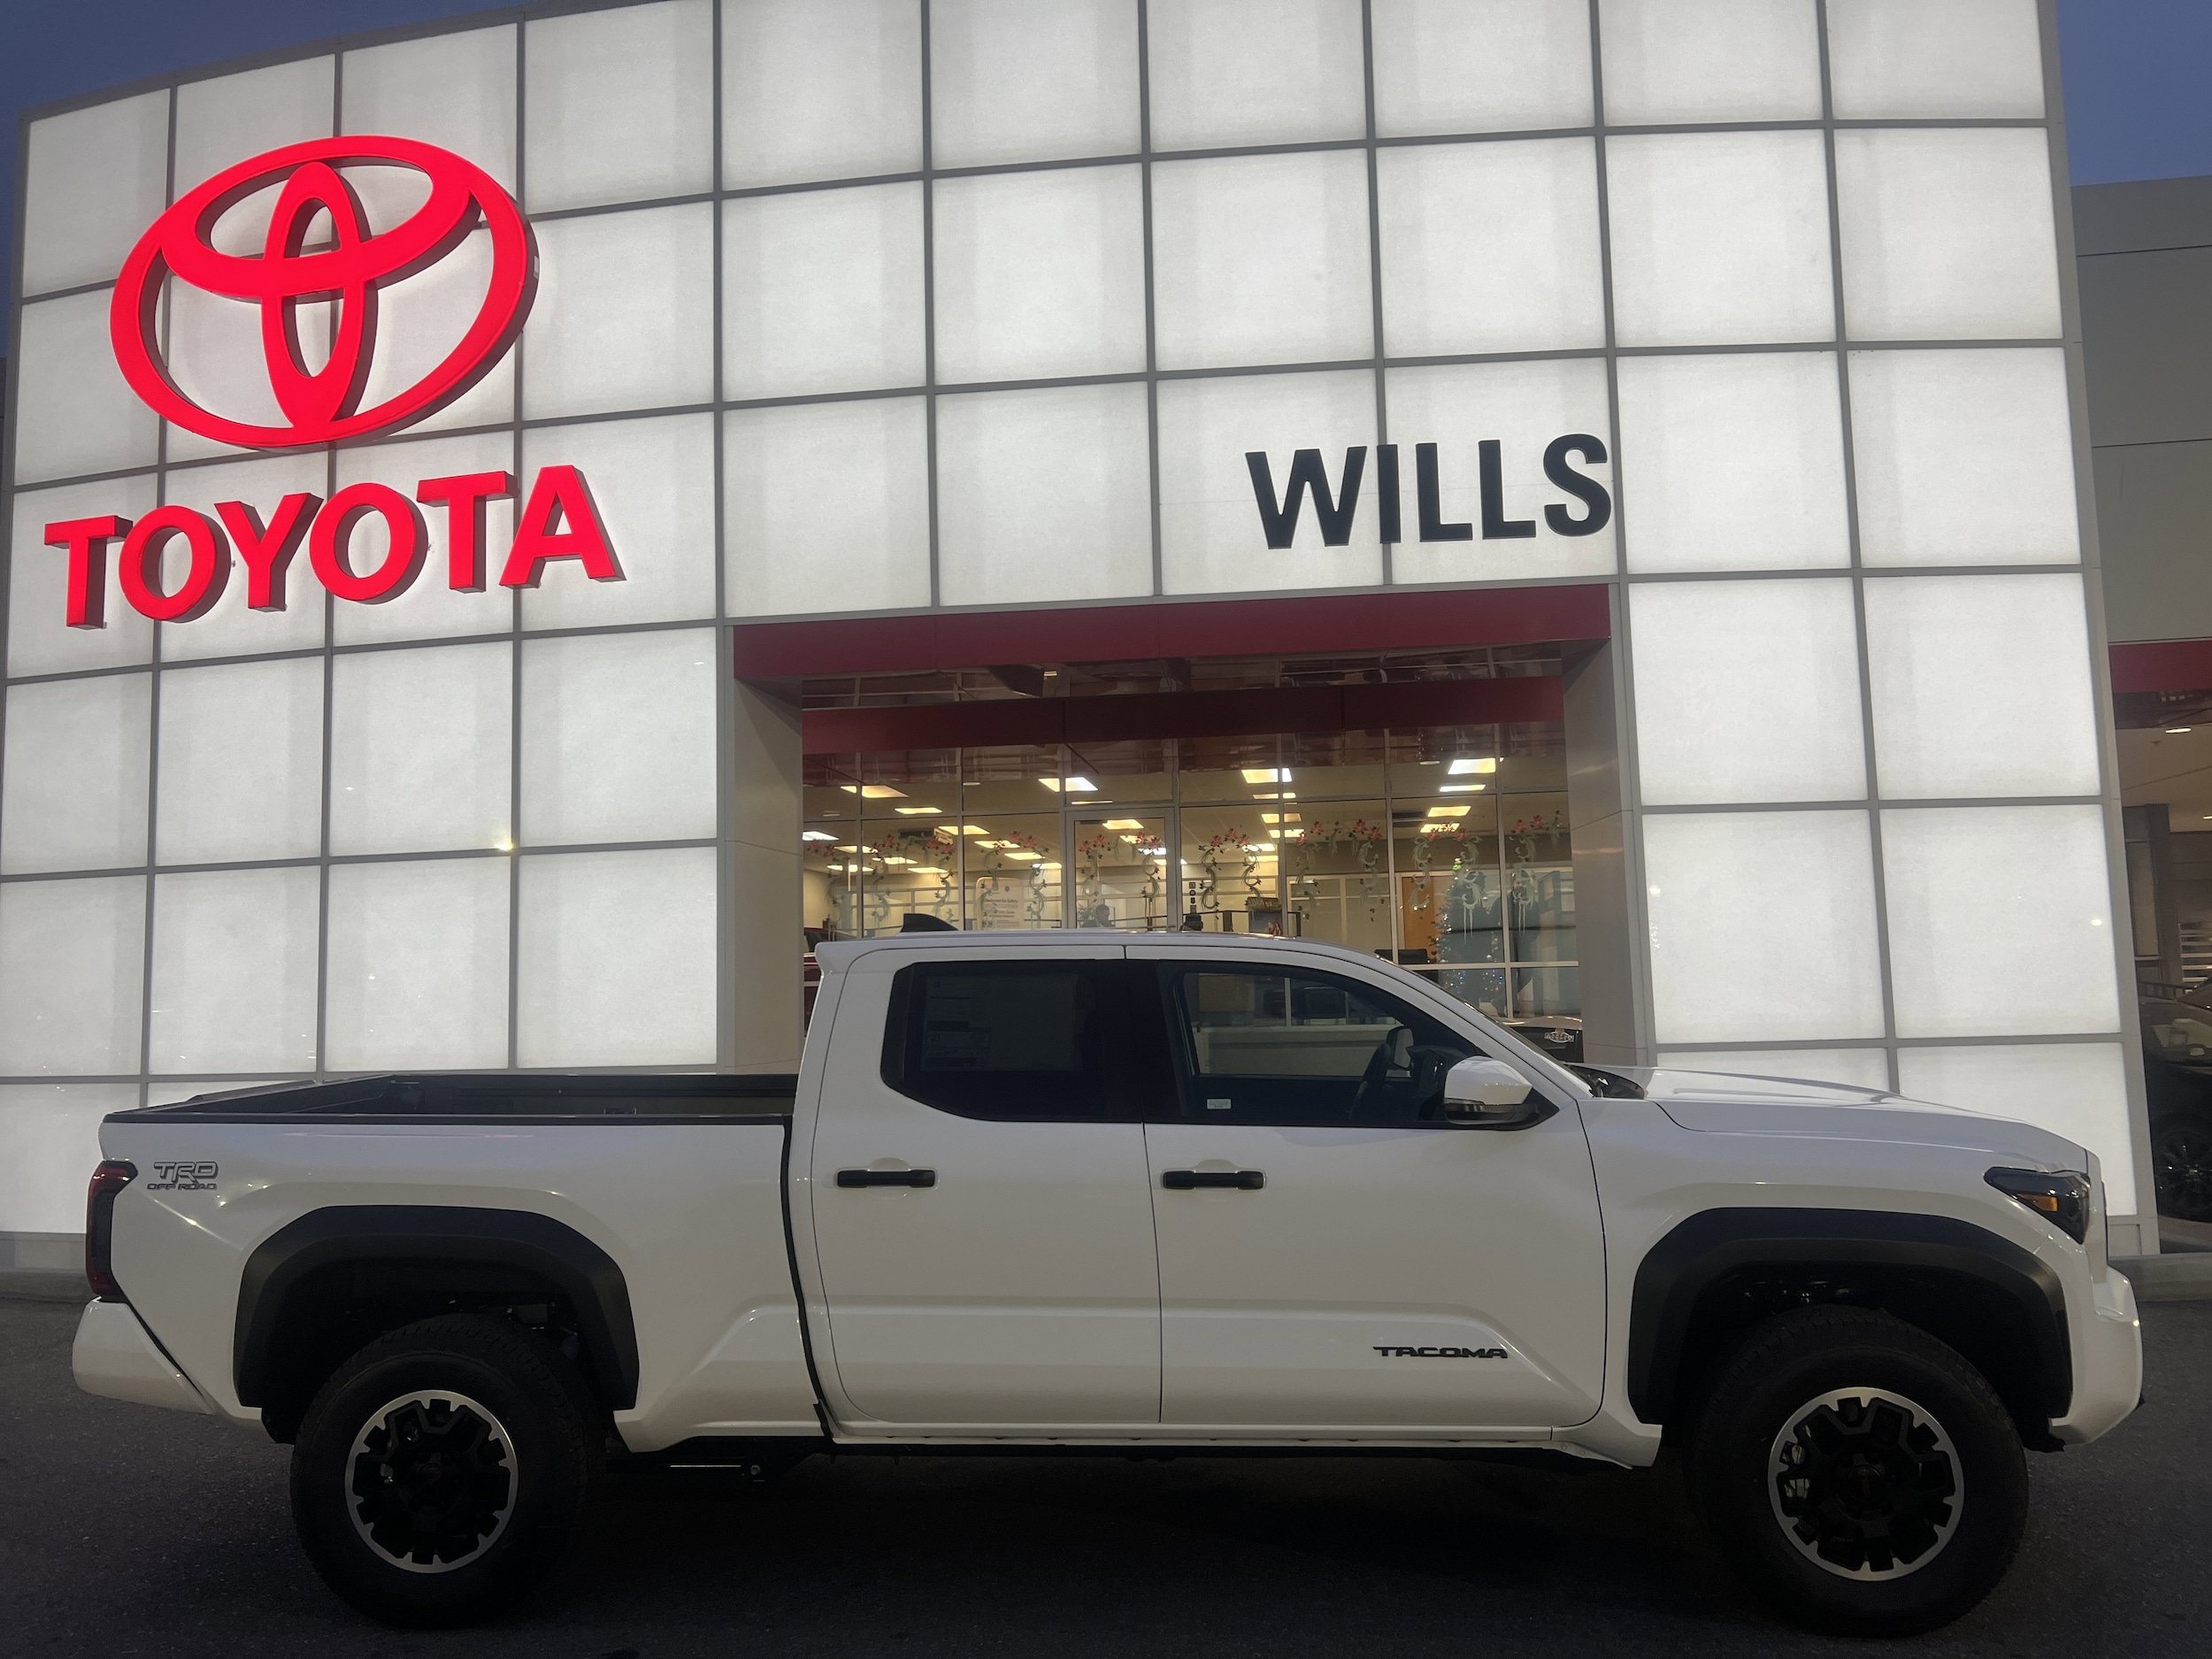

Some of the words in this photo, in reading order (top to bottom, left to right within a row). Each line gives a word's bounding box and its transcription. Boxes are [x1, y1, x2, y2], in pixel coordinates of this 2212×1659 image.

[1245, 434, 1611, 549] WILLS
[44, 465, 626, 629] TOYOTA
[153, 1161, 219, 1183] TRD
[1373, 1346, 1508, 1359] TACOMA
